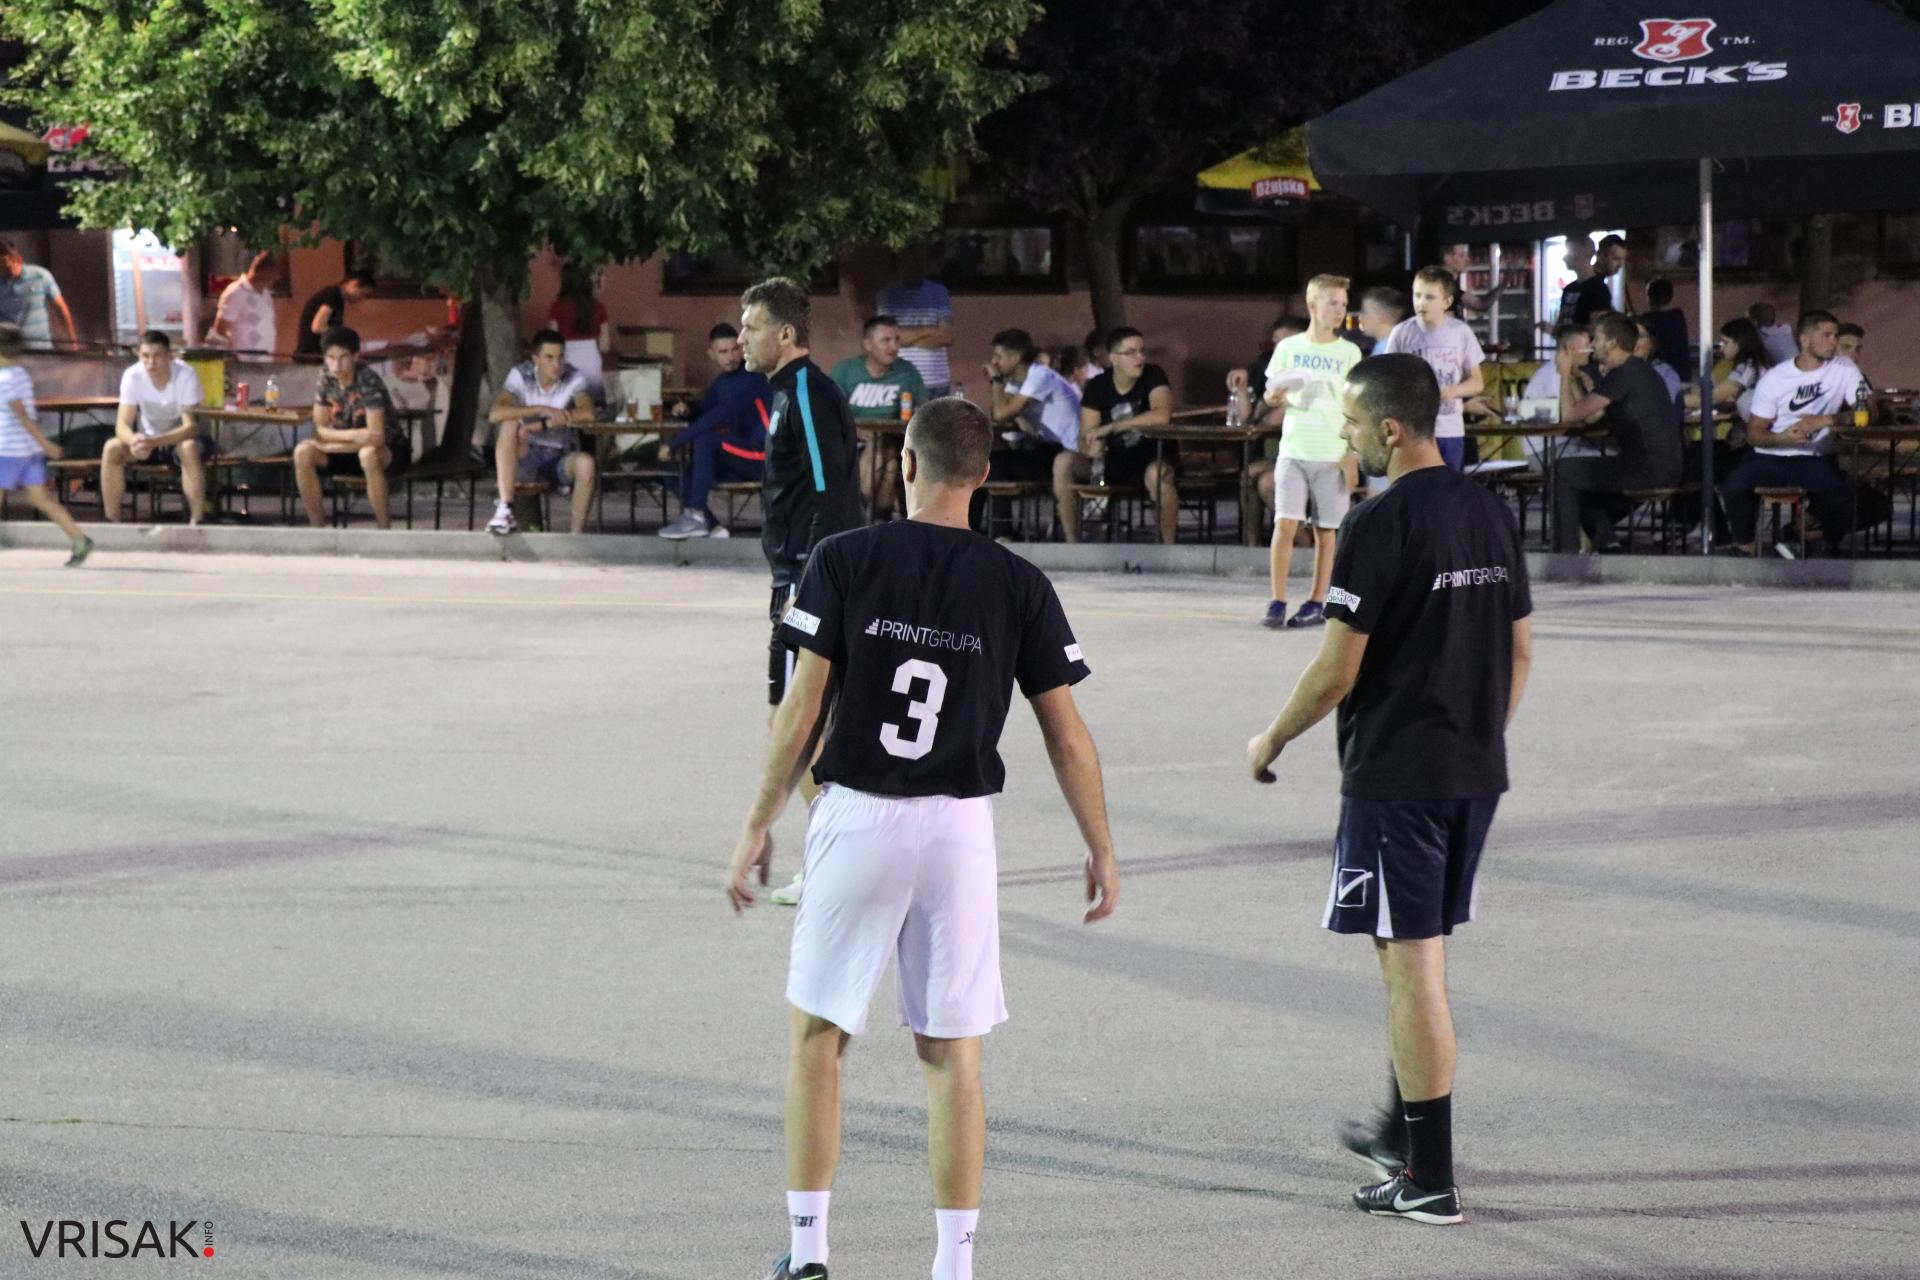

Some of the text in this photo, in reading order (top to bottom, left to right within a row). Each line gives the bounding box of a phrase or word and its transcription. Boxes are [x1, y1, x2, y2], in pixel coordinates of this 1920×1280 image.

[1594, 36, 1634, 46] REG.
[1548, 61, 1788, 91] BECK'S
[1883, 103, 1920, 128] B
[1293, 354, 1344, 374] BRONX
[849, 382, 901, 408] NIKE
[1795, 381, 1823, 400] NIKE
[880, 619, 982, 655] PRINTGRUPA
[879, 658, 948, 760] 3
